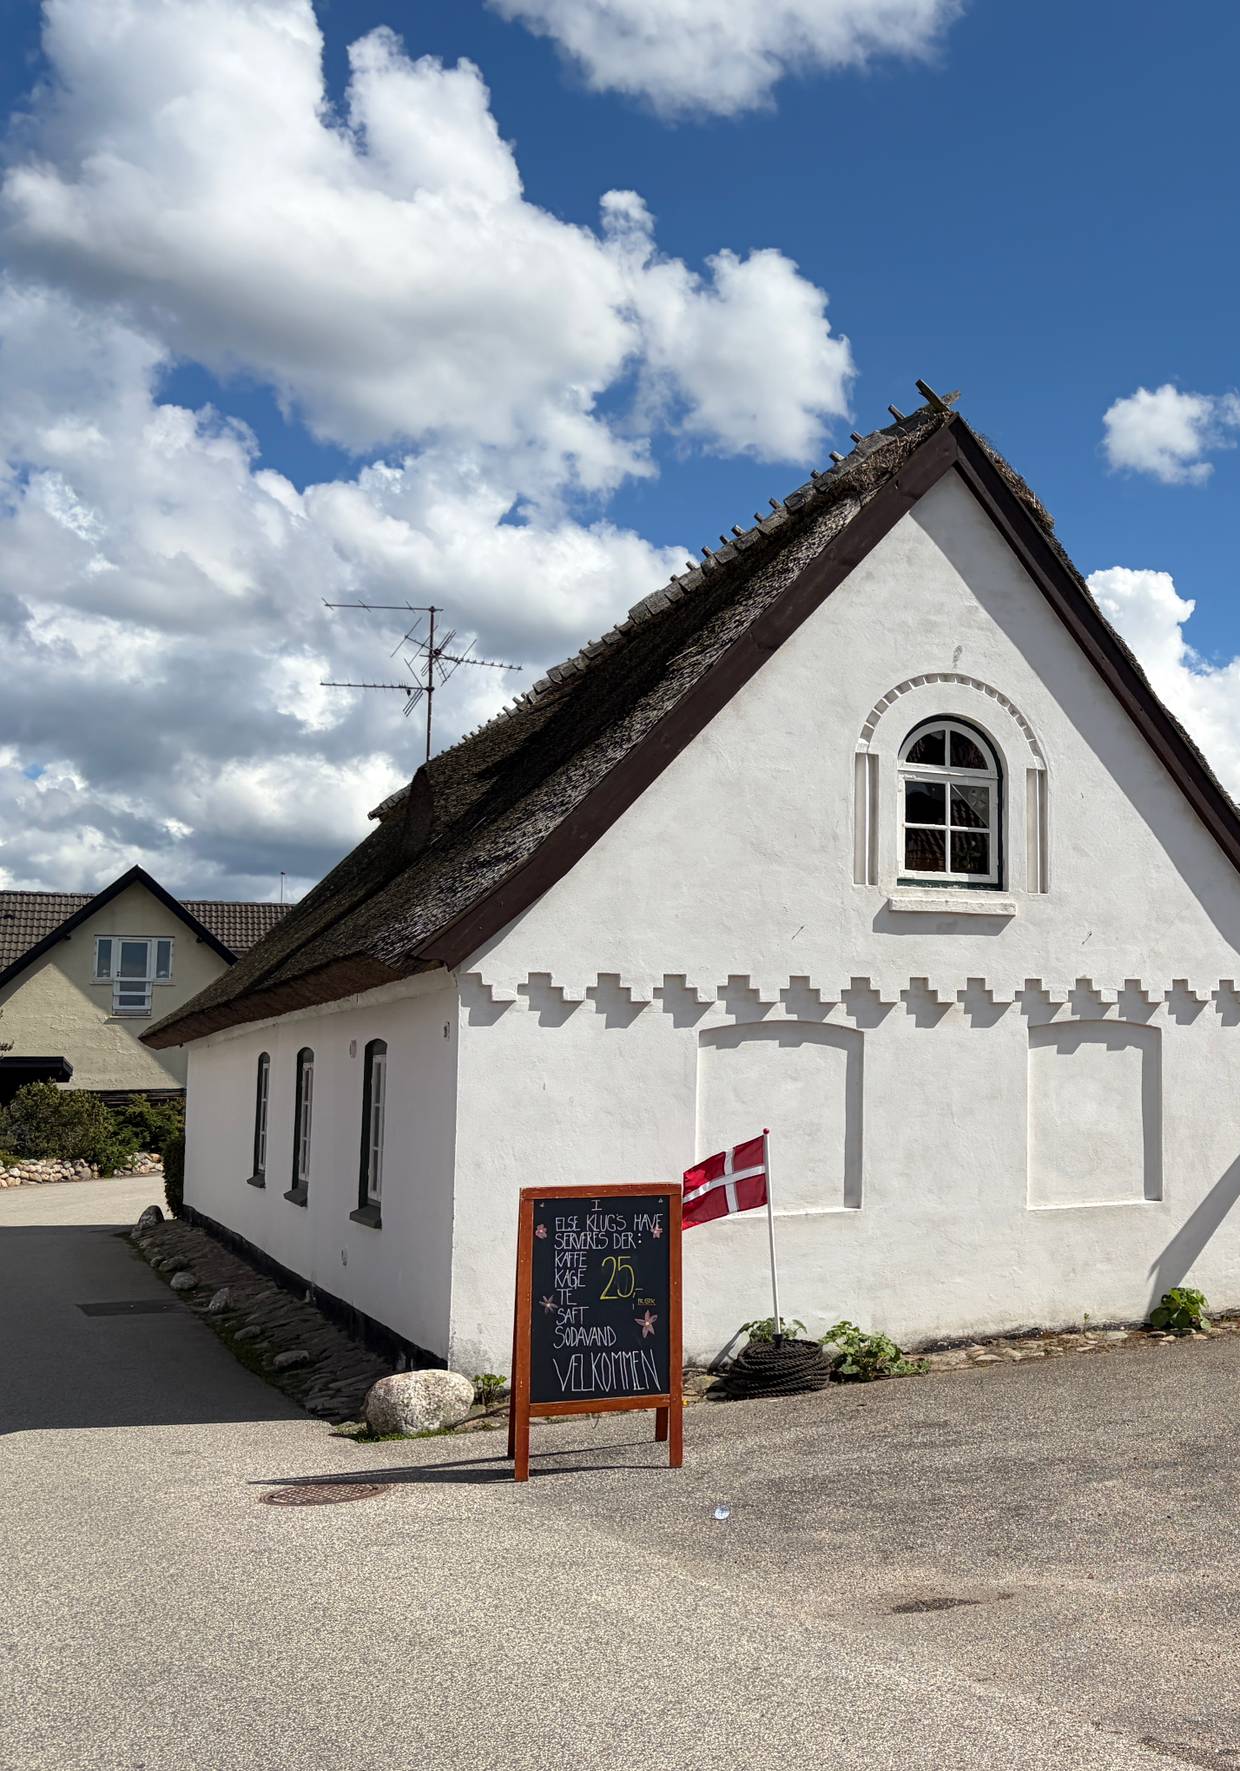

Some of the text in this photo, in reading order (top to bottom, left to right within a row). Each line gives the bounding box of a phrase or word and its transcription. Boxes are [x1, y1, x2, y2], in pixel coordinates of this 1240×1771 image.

[591, 1199, 602, 1211] I
[555, 1215, 580, 1232] ELSE
[633, 1213, 663, 1231] HAVE
[554, 1231, 609, 1249] SERVERES
[554, 1250, 588, 1268] KAFFE
[554, 1268, 587, 1289] KAGE
[556, 1288, 578, 1306] TE
[555, 1306, 589, 1326] SAFT
[553, 1325, 617, 1349] SODAVAND
[552, 1348, 661, 1392] VELKOMMEN
